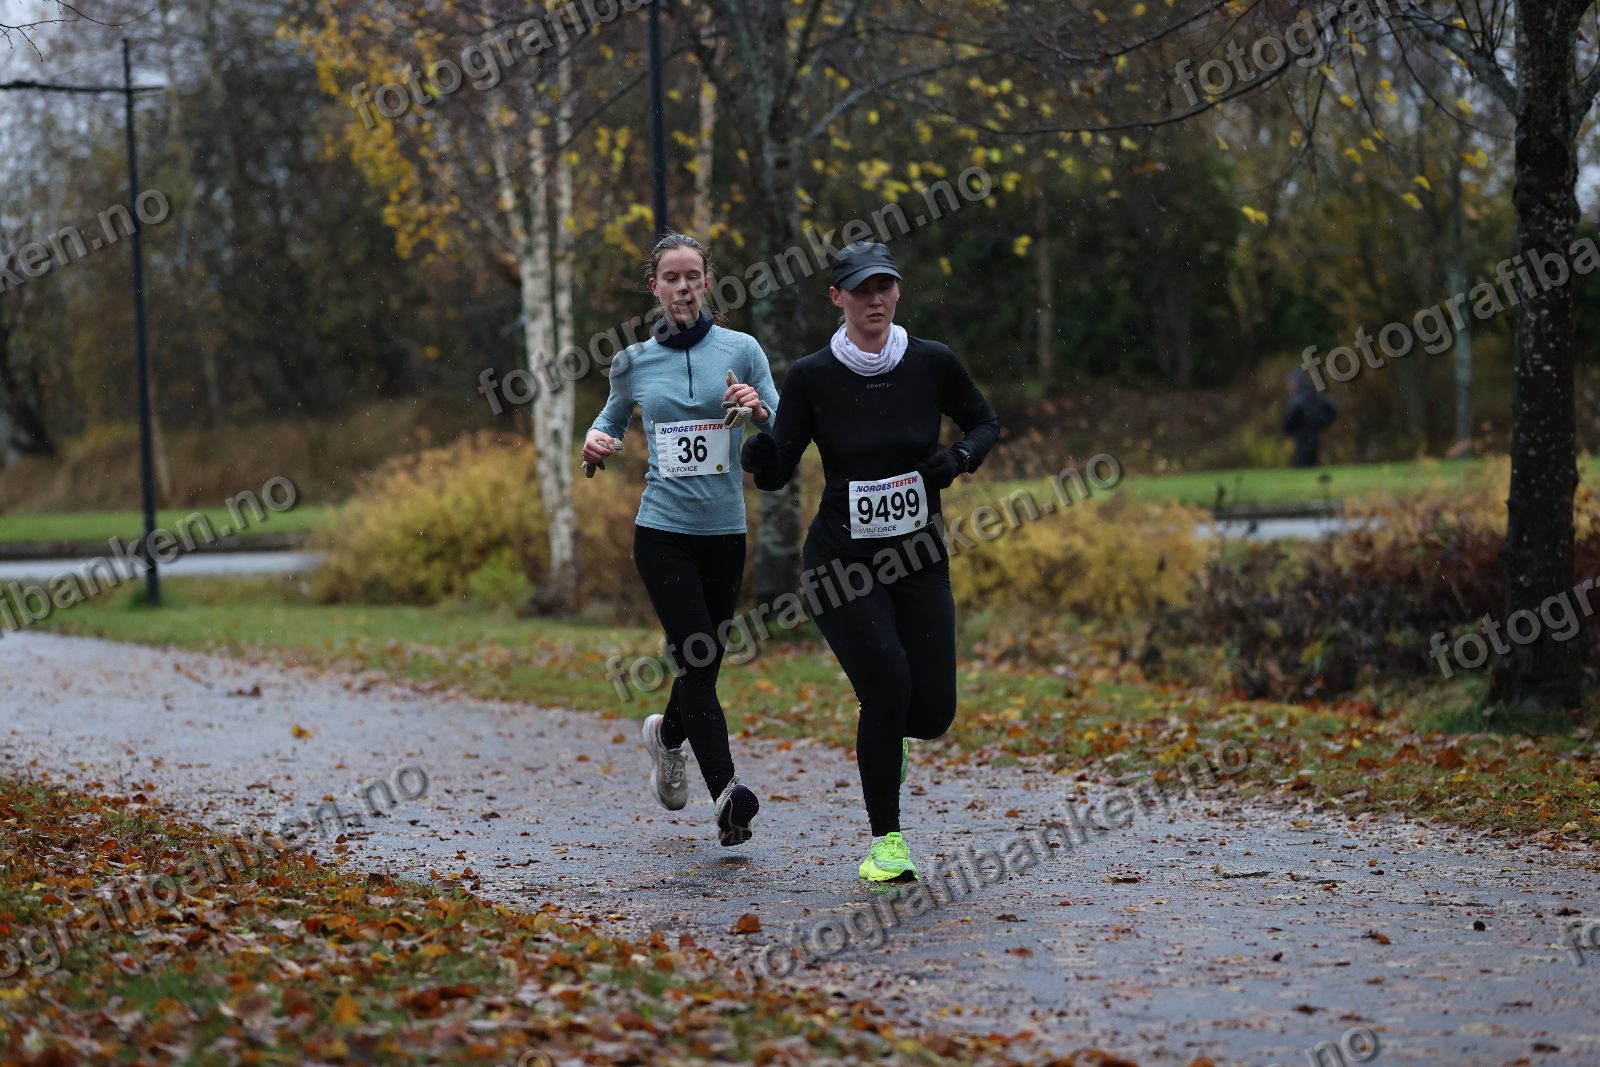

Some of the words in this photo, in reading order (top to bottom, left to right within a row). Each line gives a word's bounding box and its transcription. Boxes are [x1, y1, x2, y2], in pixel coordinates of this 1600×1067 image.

[660, 423, 724, 434] NORGESTESTEN
[677, 435, 708, 464] 36
[856, 476, 918, 492] NORGESTESTEN
[857, 488, 920, 525] 9499
